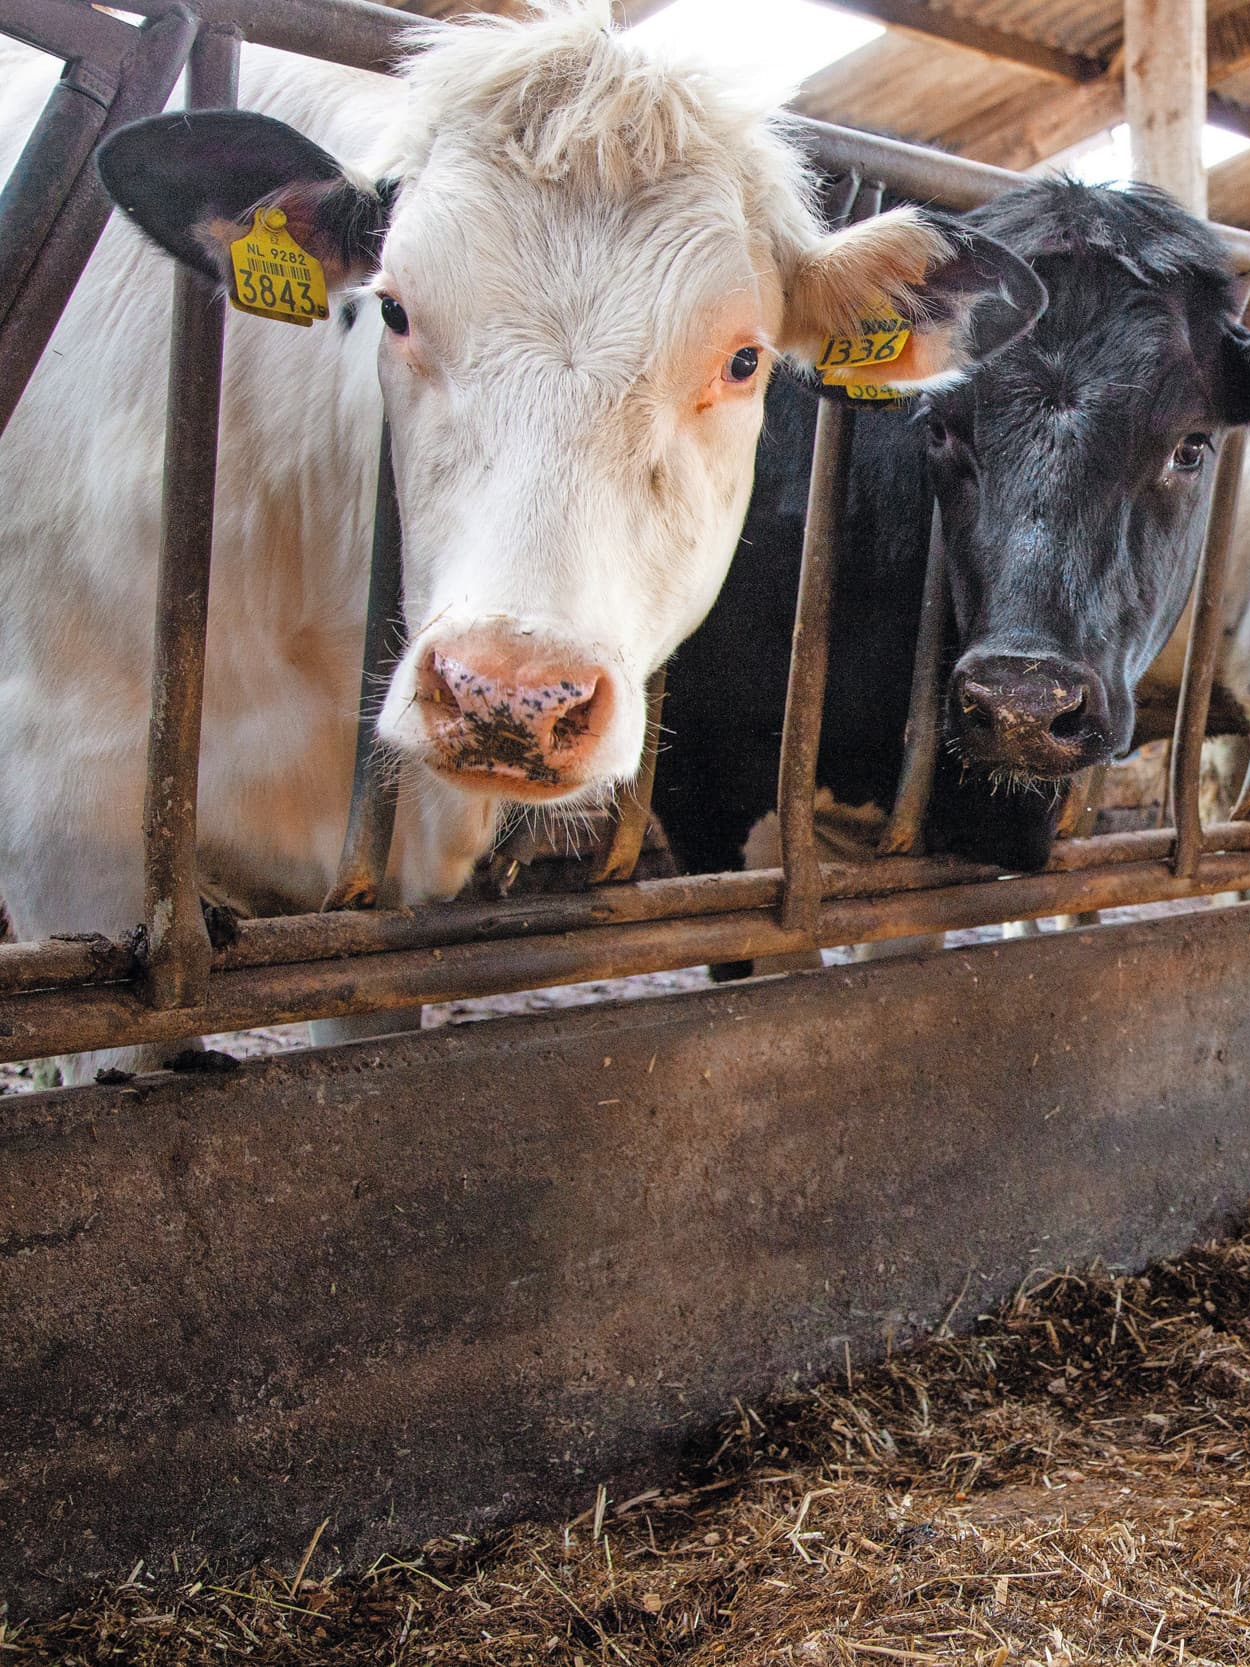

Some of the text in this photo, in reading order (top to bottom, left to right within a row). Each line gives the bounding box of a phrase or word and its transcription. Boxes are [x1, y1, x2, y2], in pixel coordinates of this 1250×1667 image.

[247, 243, 306, 266] NL 9282
[239, 269, 315, 315] 3843
[820, 334, 899, 366] 1336
